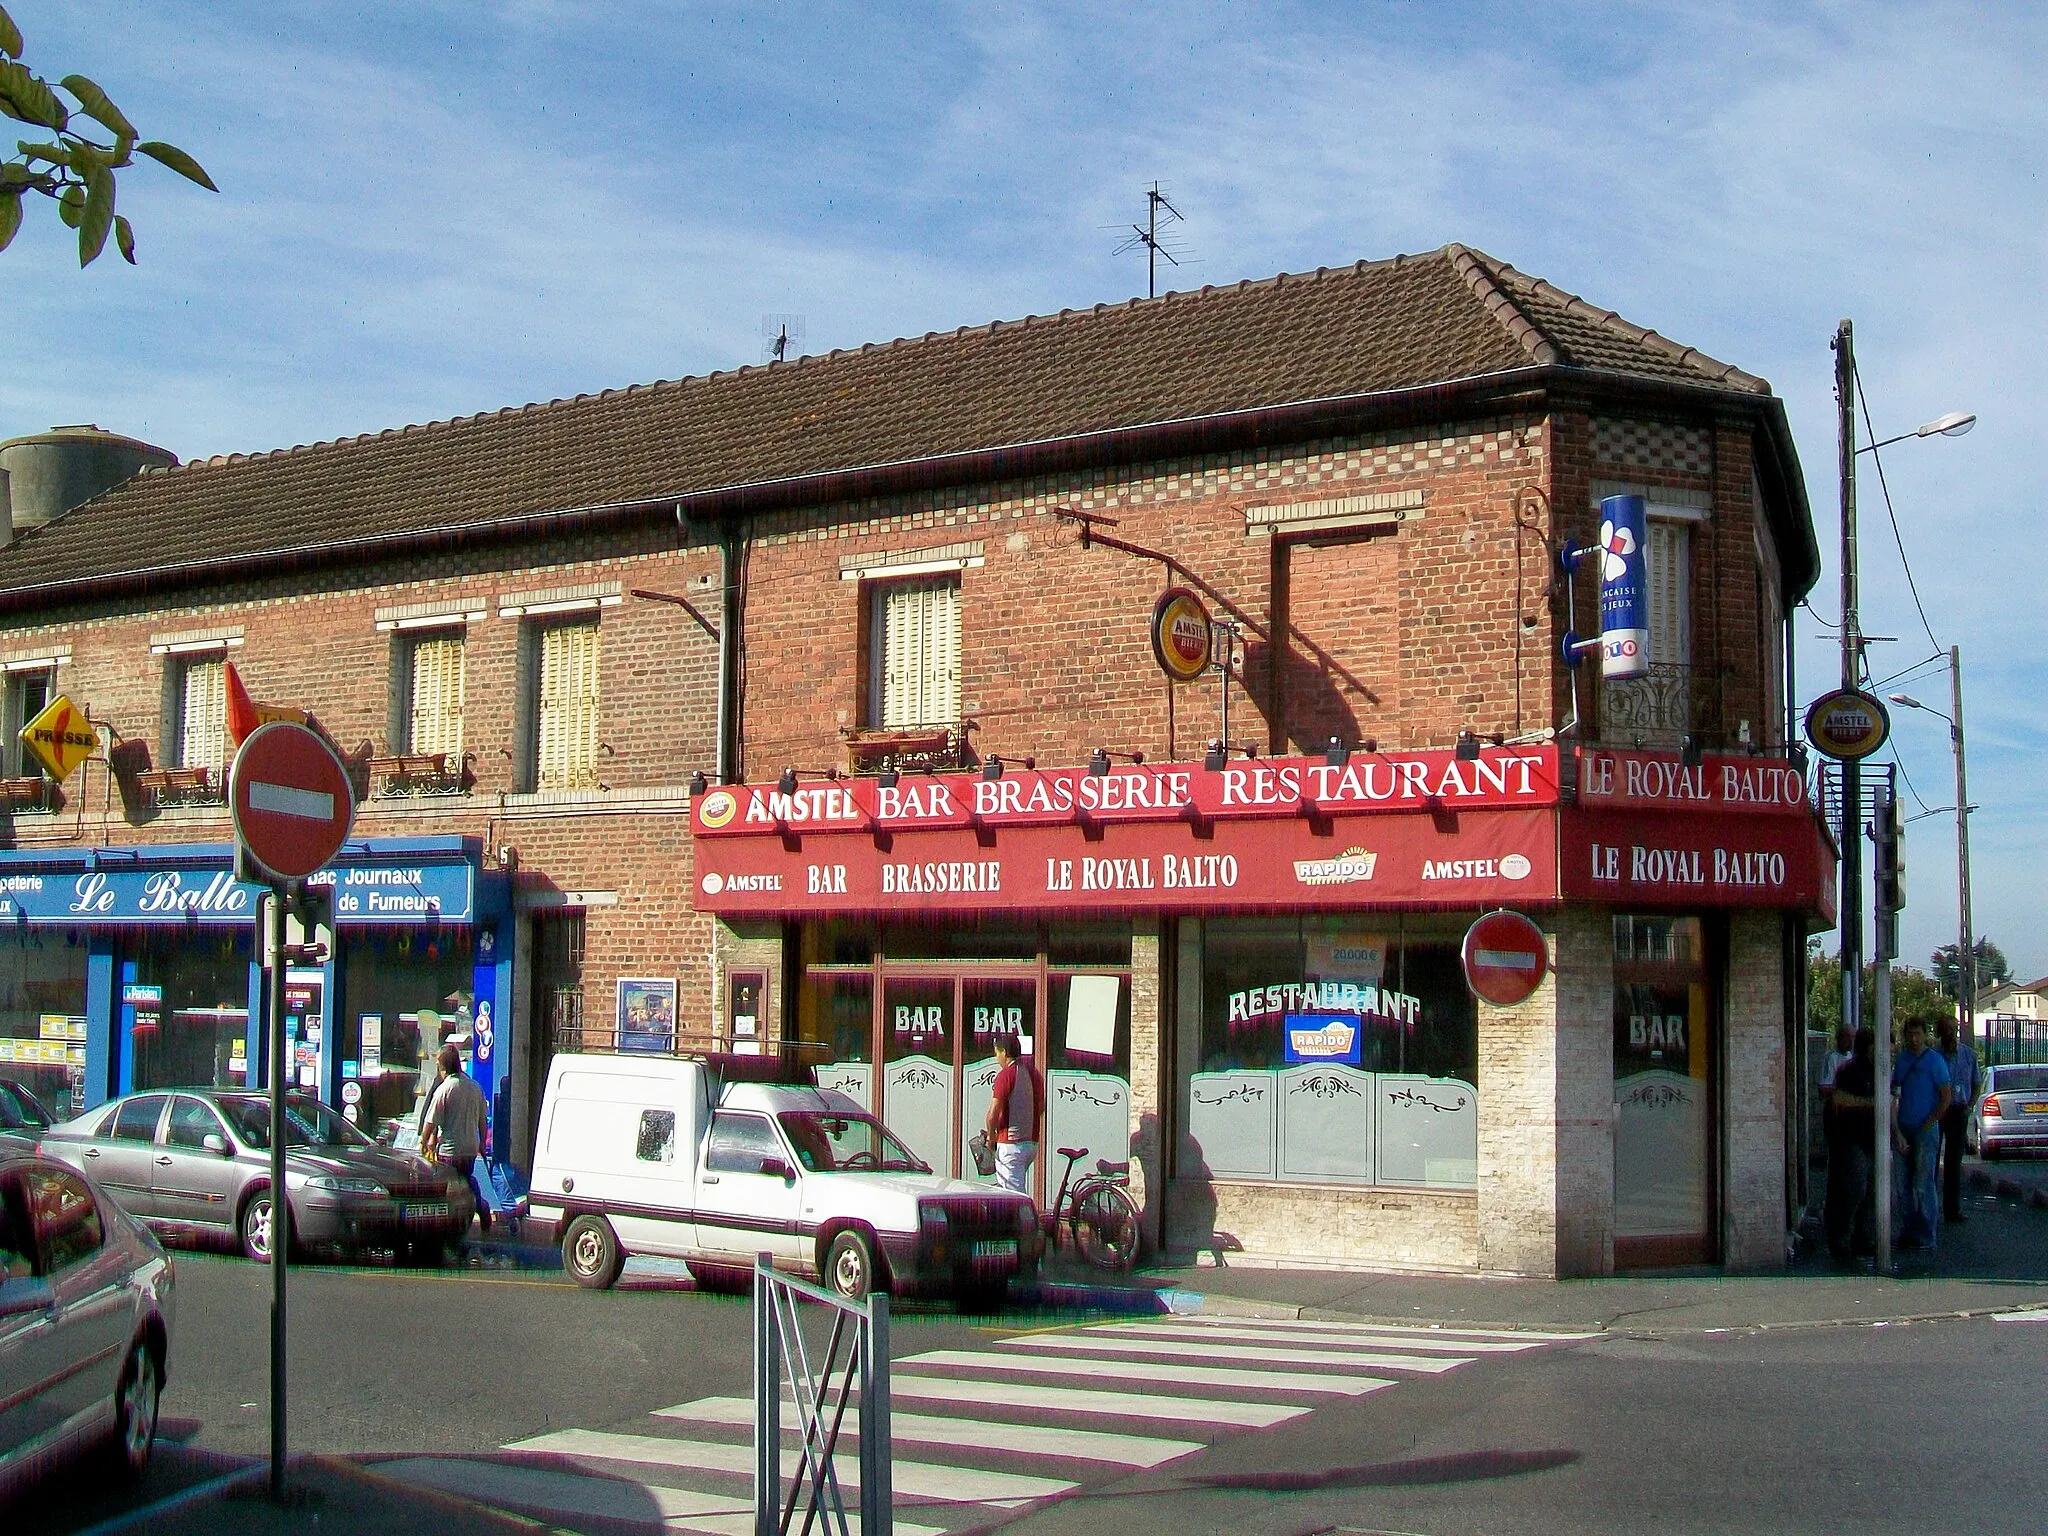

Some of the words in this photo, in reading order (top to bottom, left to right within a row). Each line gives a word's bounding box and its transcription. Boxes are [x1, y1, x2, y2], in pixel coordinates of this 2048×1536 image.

[1608, 600, 1632, 611] JEUX
[1603, 640, 1638, 661] OTO
[1825, 715, 1870, 726] AMSTEL
[744, 788, 859, 823] AMSTEL
[876, 783, 954, 819] BAR
[972, 772, 1192, 815] BRASSERIE
[1219, 756, 1543, 805] RESTAURANT
[1584, 756, 1615, 795] LE
[1626, 759, 1711, 801] ROYAL
[1721, 765, 1803, 806] BALTO
[344, 867, 422, 885] Journaux
[807, 864, 847, 894] BAR
[882, 861, 1000, 893] BRASSERIE
[1046, 858, 1072, 891] LE
[1081, 856, 1154, 890] ROYAL
[1162, 854, 1238, 888] BALTO
[1299, 861, 1368, 877] RAPIDO
[1421, 859, 1499, 880] AMSTEL
[1592, 843, 1619, 879] LE
[1631, 846, 1704, 883] ROYAL
[1713, 848, 1785, 885] BALTO
[68, 872, 116, 912] Le
[725, 873, 783, 892] AMSTEL
[338, 893, 359, 911] de
[368, 892, 441, 911] Fumeurs
[1228, 982, 1421, 1025] RESTAURANT
[895, 1006, 945, 1035] BAR
[974, 1007, 1025, 1036] BAR
[1629, 1015, 1686, 1050] BAR
[1296, 1034, 1346, 1047] RAPIDO
